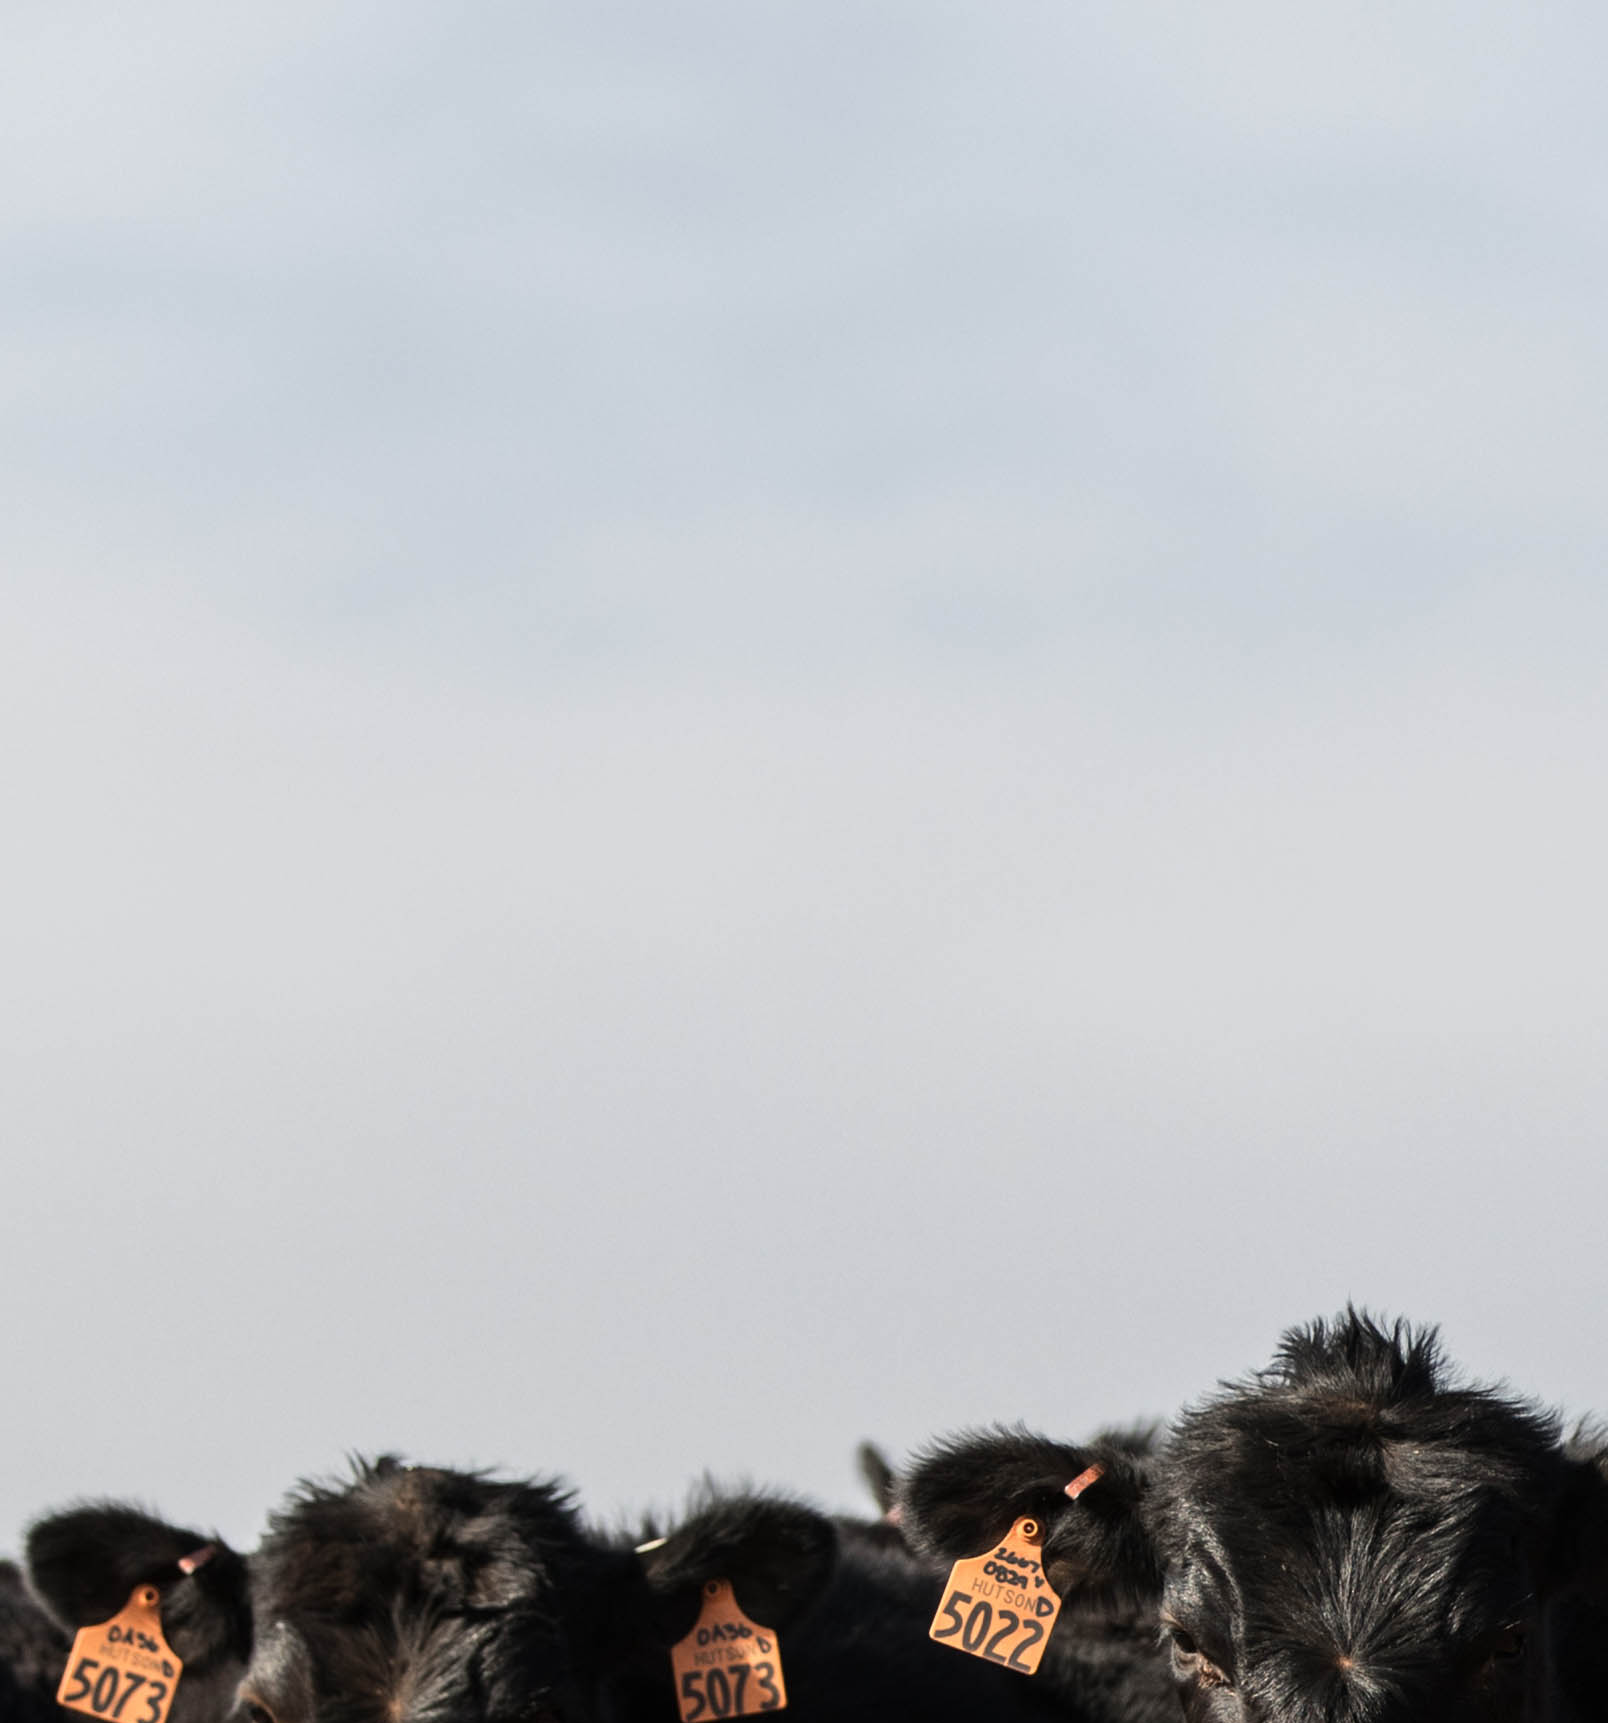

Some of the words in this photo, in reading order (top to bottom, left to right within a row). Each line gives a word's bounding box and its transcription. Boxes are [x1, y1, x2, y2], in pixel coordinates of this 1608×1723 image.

[972, 1578, 1036, 1612] HUTSON
[1035, 1596, 1054, 1617] D
[934, 1590, 1044, 1673] 5022
[682, 1662, 780, 1721] 5073
